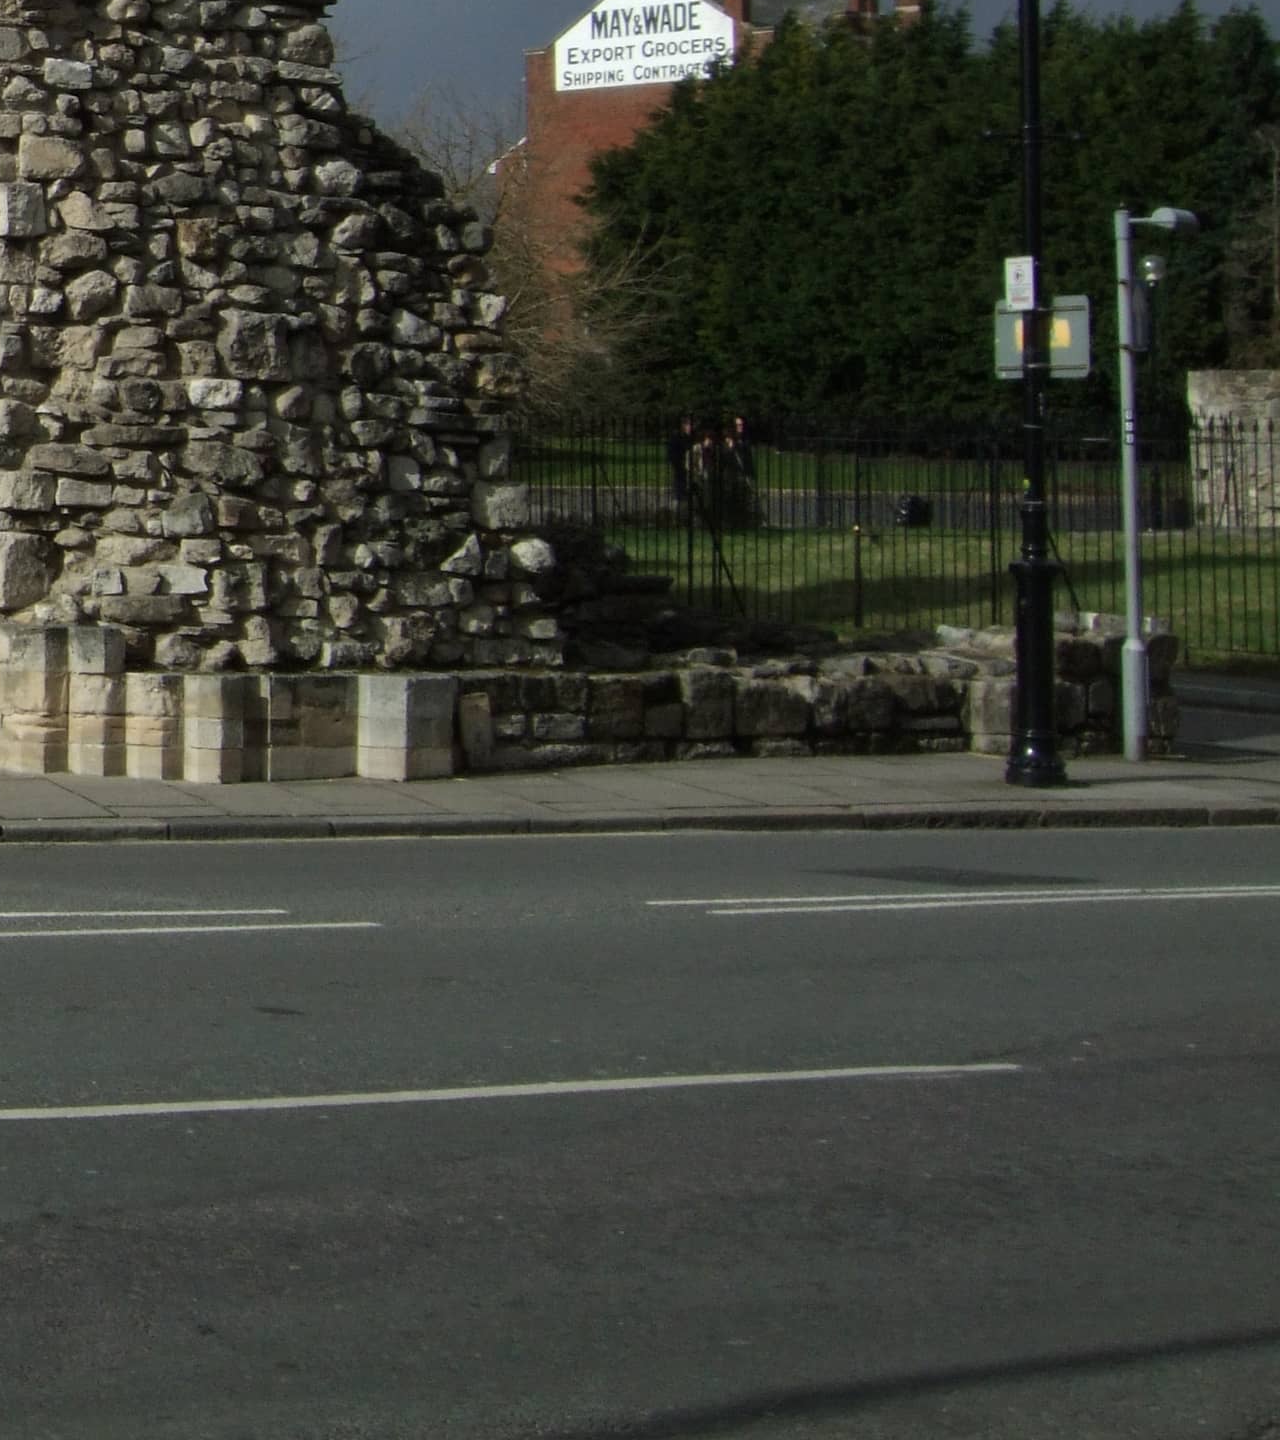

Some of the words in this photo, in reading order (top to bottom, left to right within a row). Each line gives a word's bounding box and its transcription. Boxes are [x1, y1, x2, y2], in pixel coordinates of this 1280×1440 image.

[567, 44, 636, 65] EXPORT
[642, 36, 726, 58] GROCERS
[563, 69, 625, 87] SHIPPING
